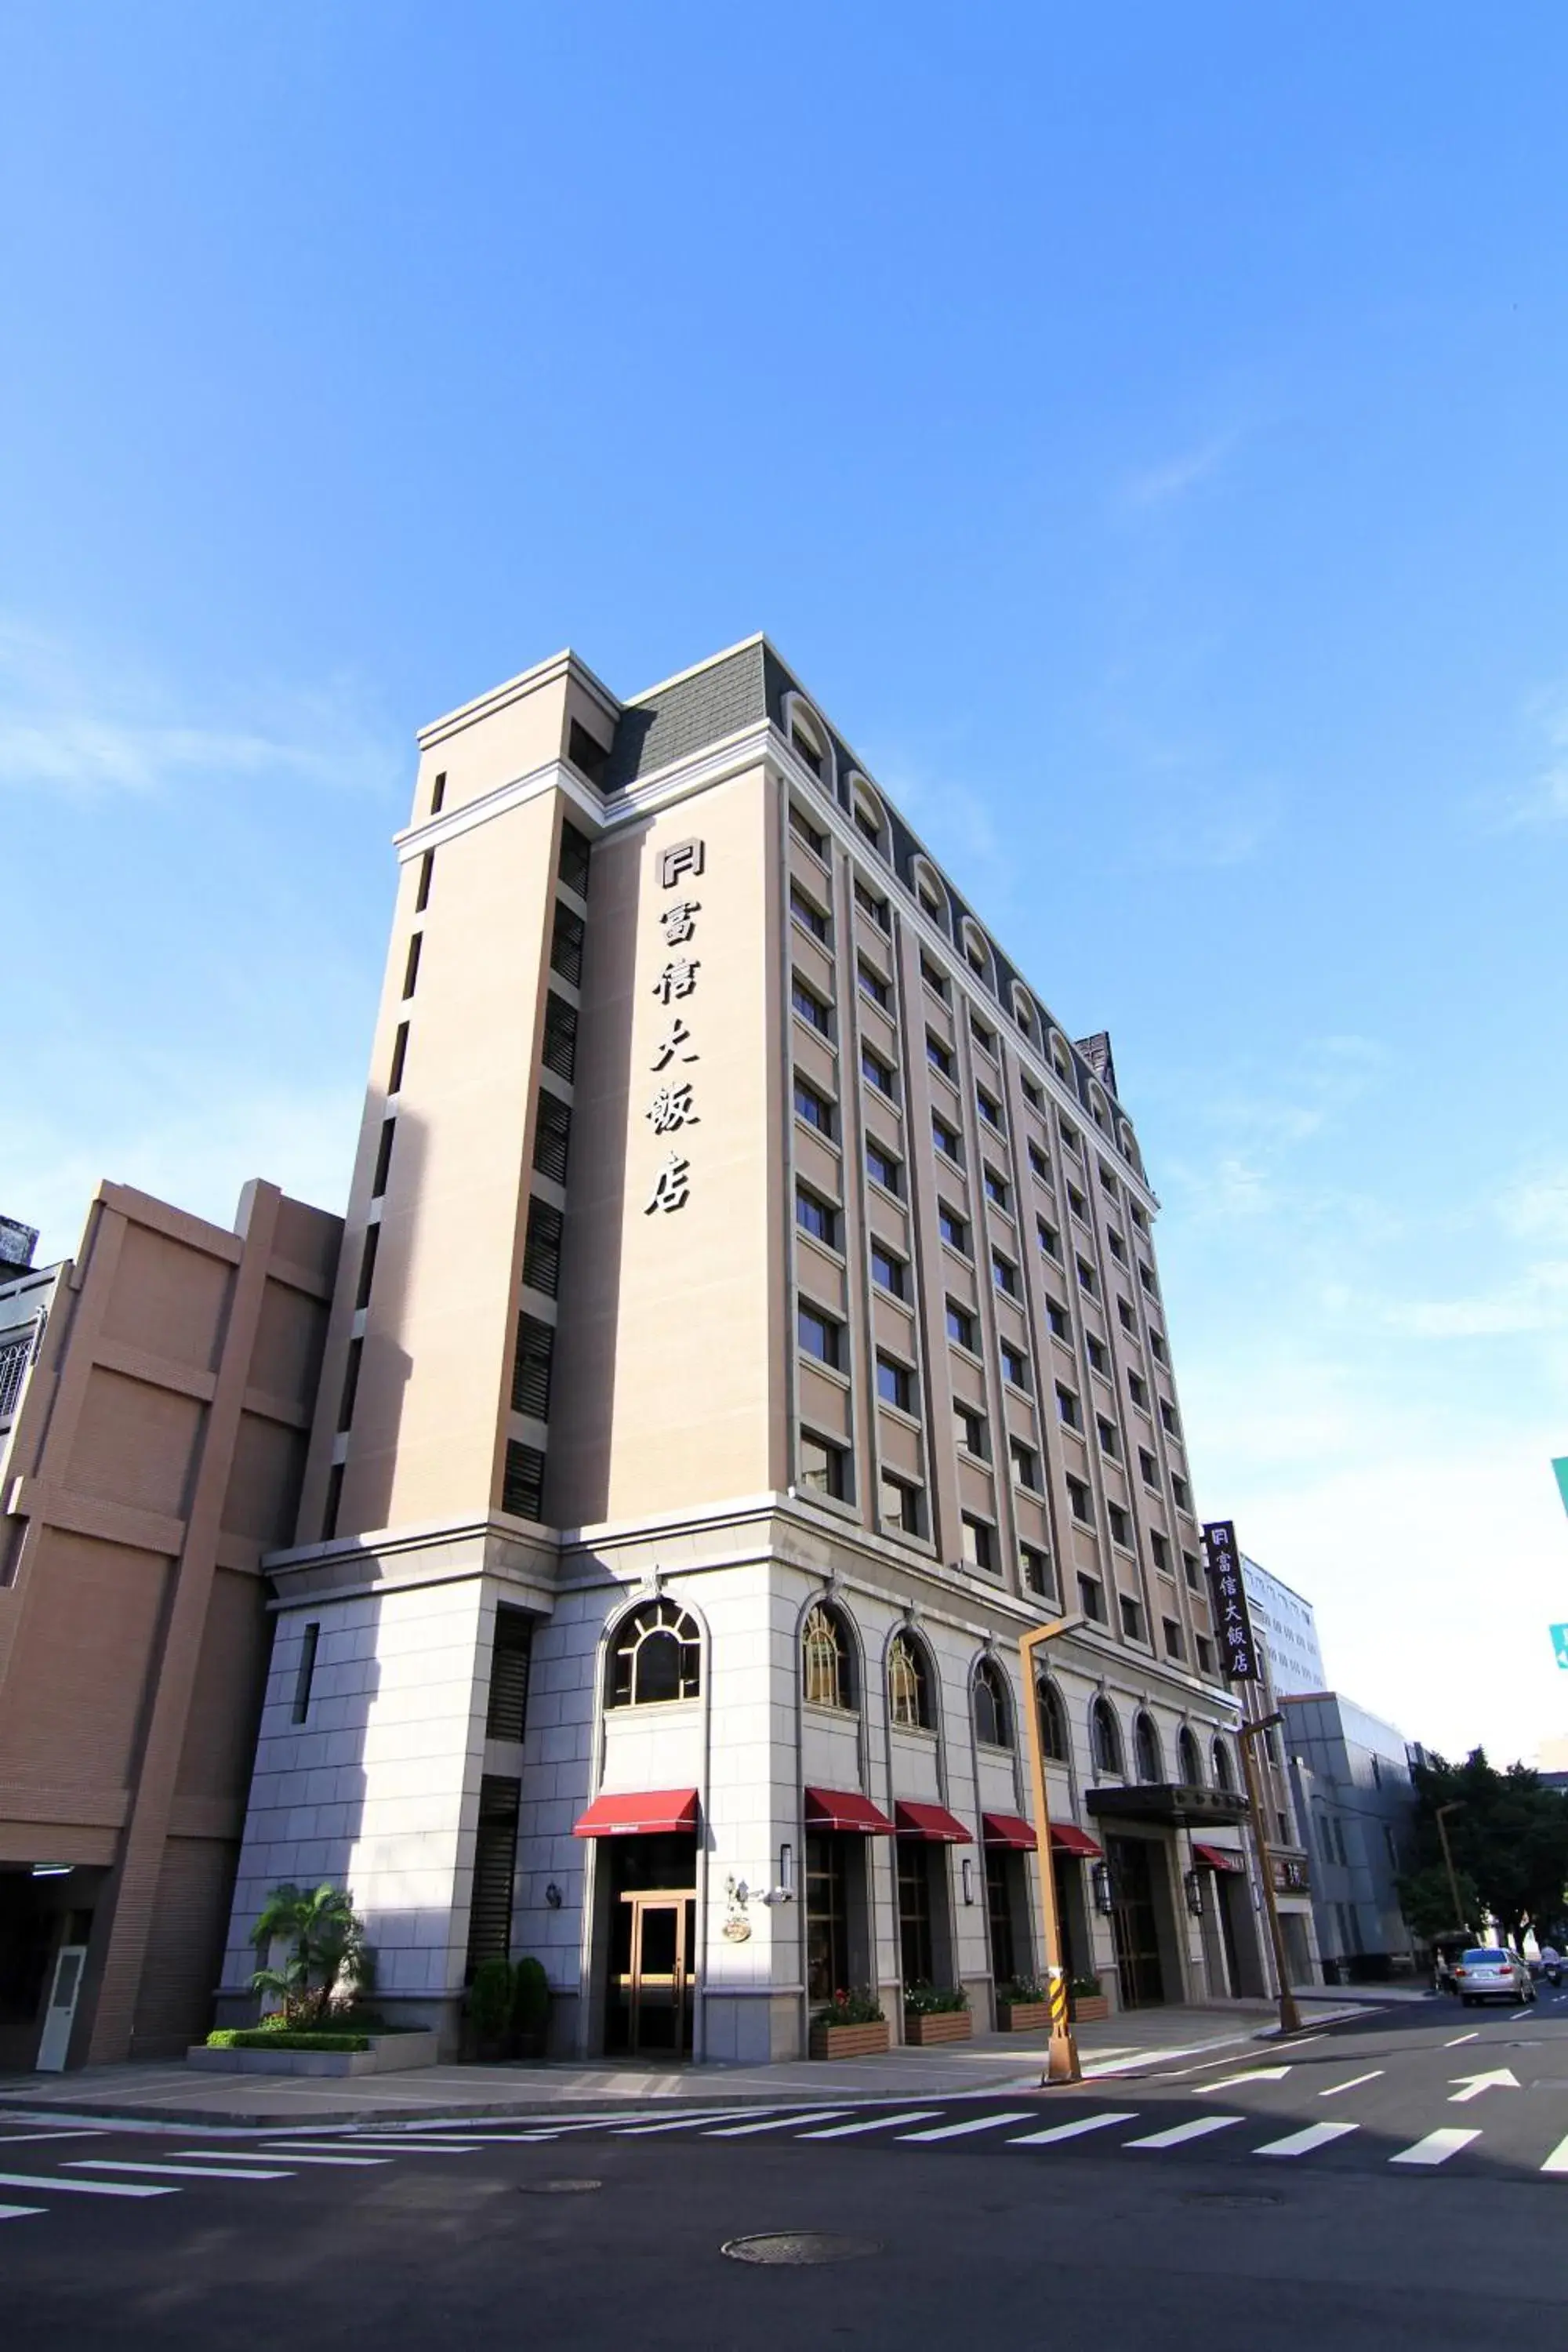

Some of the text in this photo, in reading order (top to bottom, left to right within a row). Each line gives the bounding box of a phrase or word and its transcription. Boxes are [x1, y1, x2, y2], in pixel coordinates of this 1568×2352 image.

[645, 898, 702, 1216] 富信大飯店
[1216, 1551, 1248, 1673] 富信大飯店
